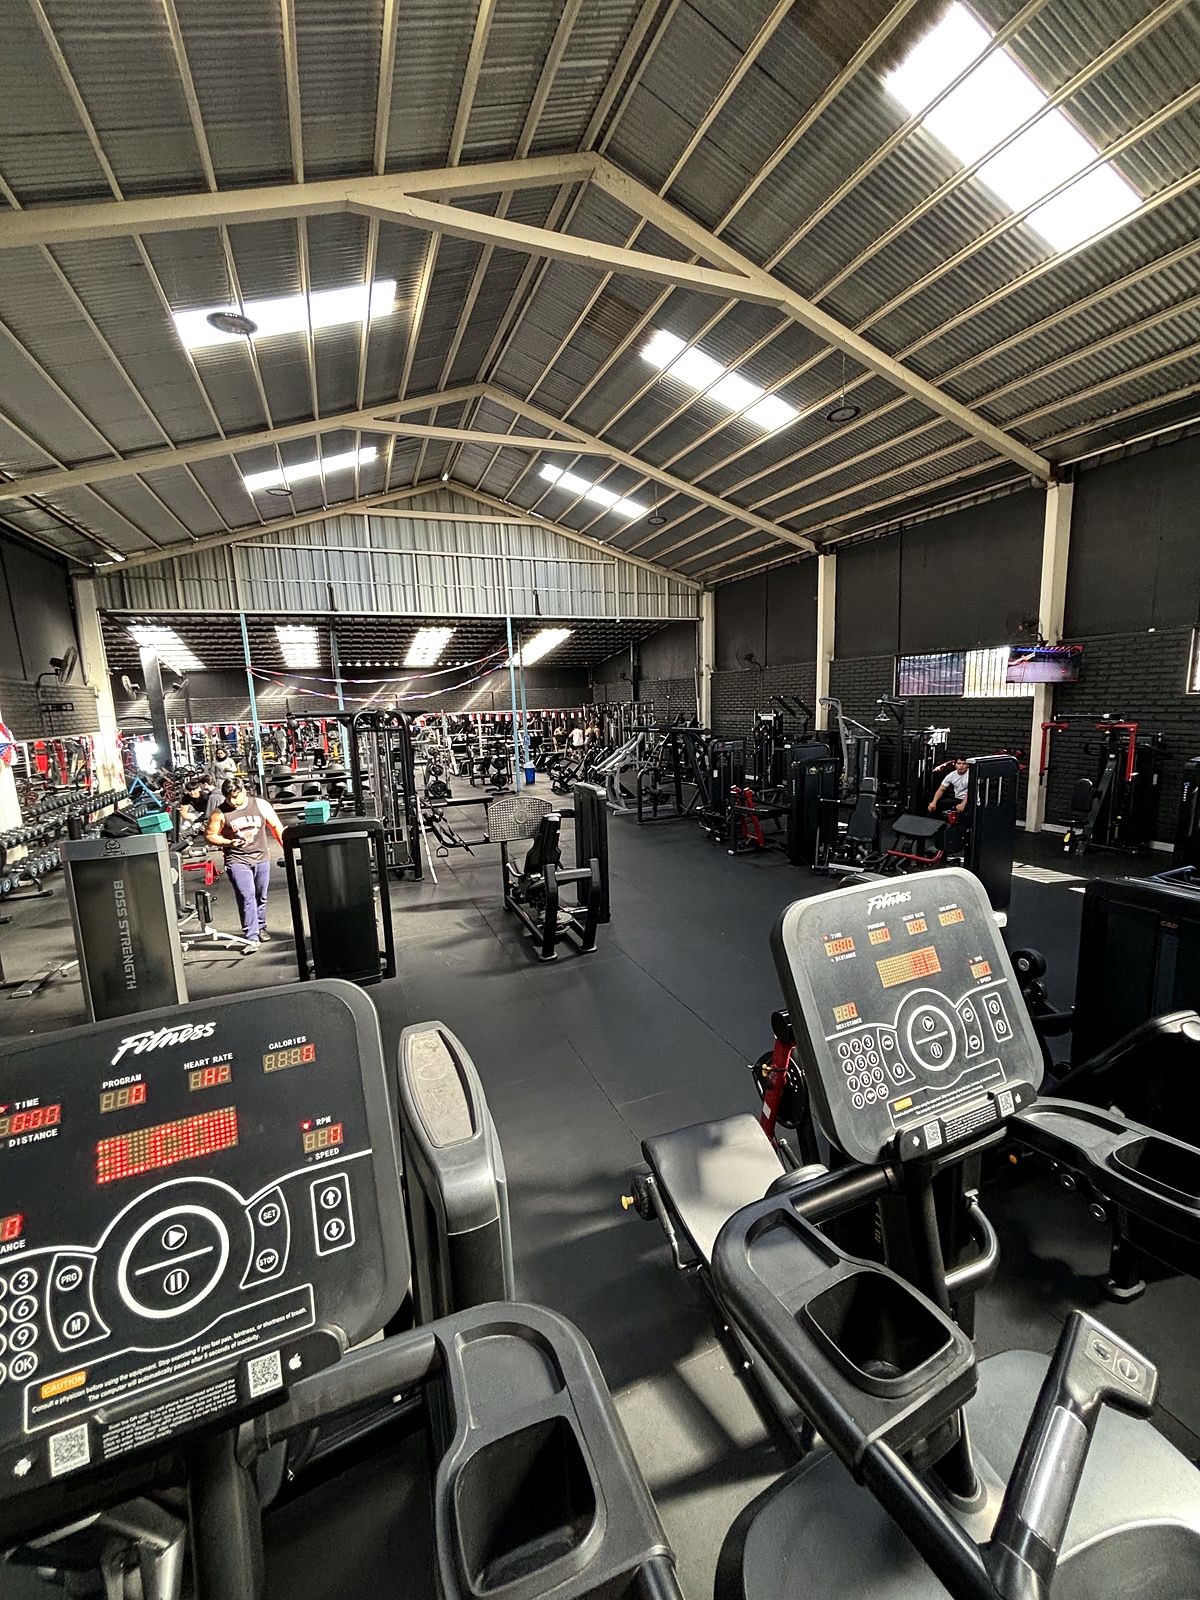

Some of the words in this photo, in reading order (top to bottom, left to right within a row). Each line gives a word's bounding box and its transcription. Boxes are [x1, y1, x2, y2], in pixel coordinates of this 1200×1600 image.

[113, 880, 127, 917] BOSS
[118, 919, 137, 990] STRENGTH
[111, 1022, 217, 1065] Fitness
[268, 1036, 307, 1050] CALORIES
[184, 1058, 210, 1070] HEART
[212, 1052, 234, 1064] RATE
[102, 1074, 142, 1089] PROGRAM
[15, 1098, 40, 1110] TIME
[316, 1116, 332, 1126] RPM
[8, 1128, 58, 1148] DISTANCE
[315, 1147, 340, 1161] SPEED
[262, 1209, 276, 1220] SET
[259, 1255, 276, 1267] STOP
[18, 1273, 29, 1289] 3
[60, 1272, 78, 1285] PRG
[17, 1301, 29, 1316] 6
[71, 1318, 81, 1332] M
[17, 1328, 29, 1345] 9
[14, 1356, 33, 1373] OK
[44, 1373, 86, 1395] CAUTION
[88, 1394, 100, 1402] The
